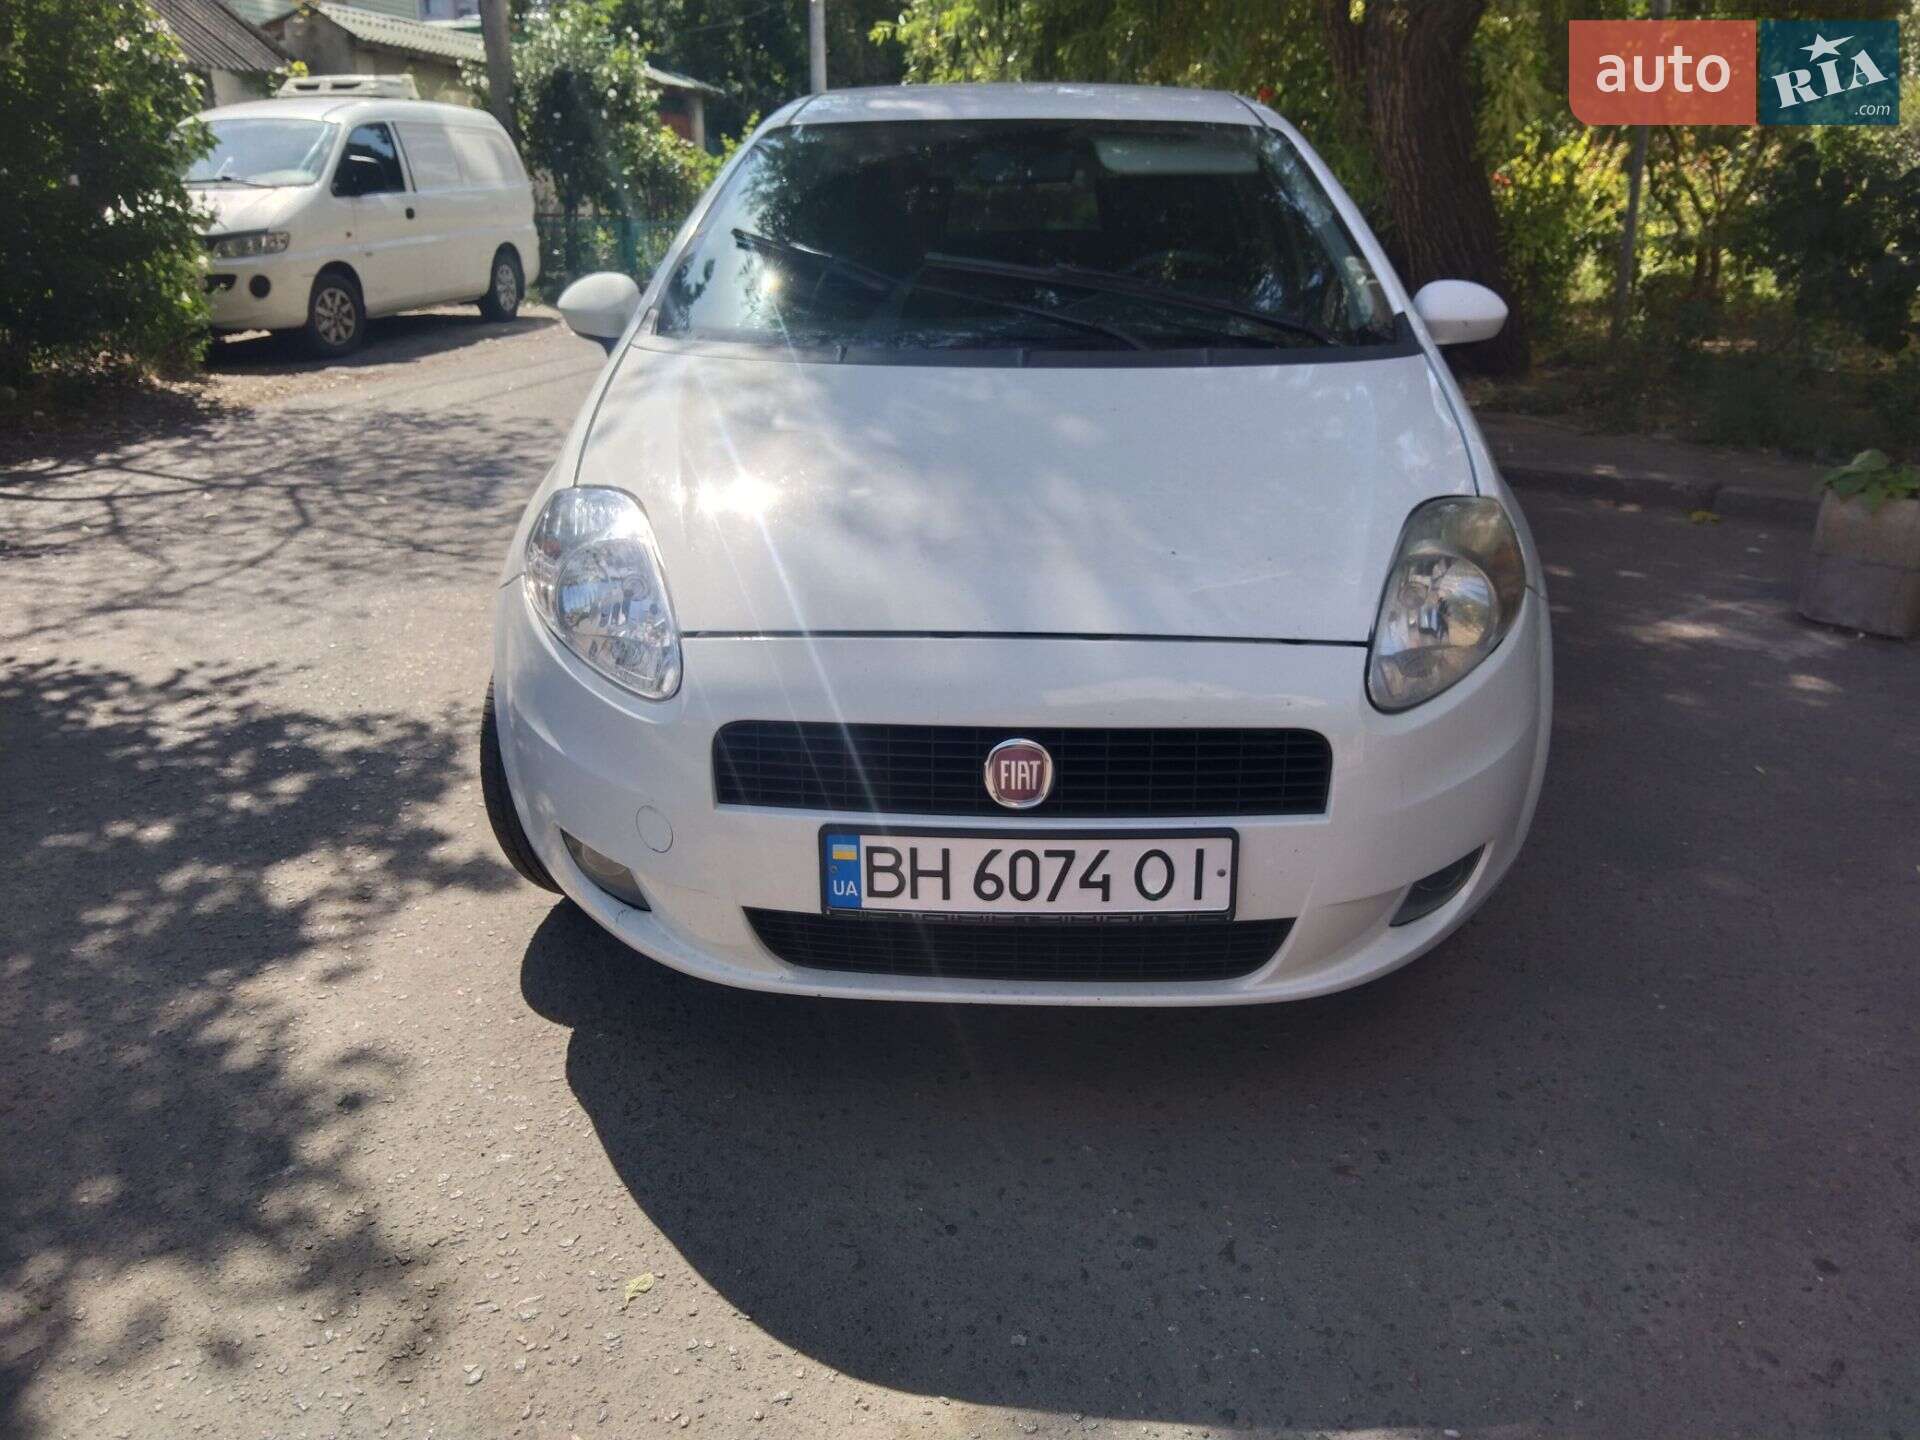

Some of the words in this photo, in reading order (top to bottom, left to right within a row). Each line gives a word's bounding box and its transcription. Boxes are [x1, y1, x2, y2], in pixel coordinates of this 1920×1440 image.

[1000, 760, 1041, 790] FIAT
[832, 880, 858, 897] UA
[865, 845, 950, 900] BH
[972, 848, 1111, 902] 6074
[1134, 848, 1205, 901] OI
